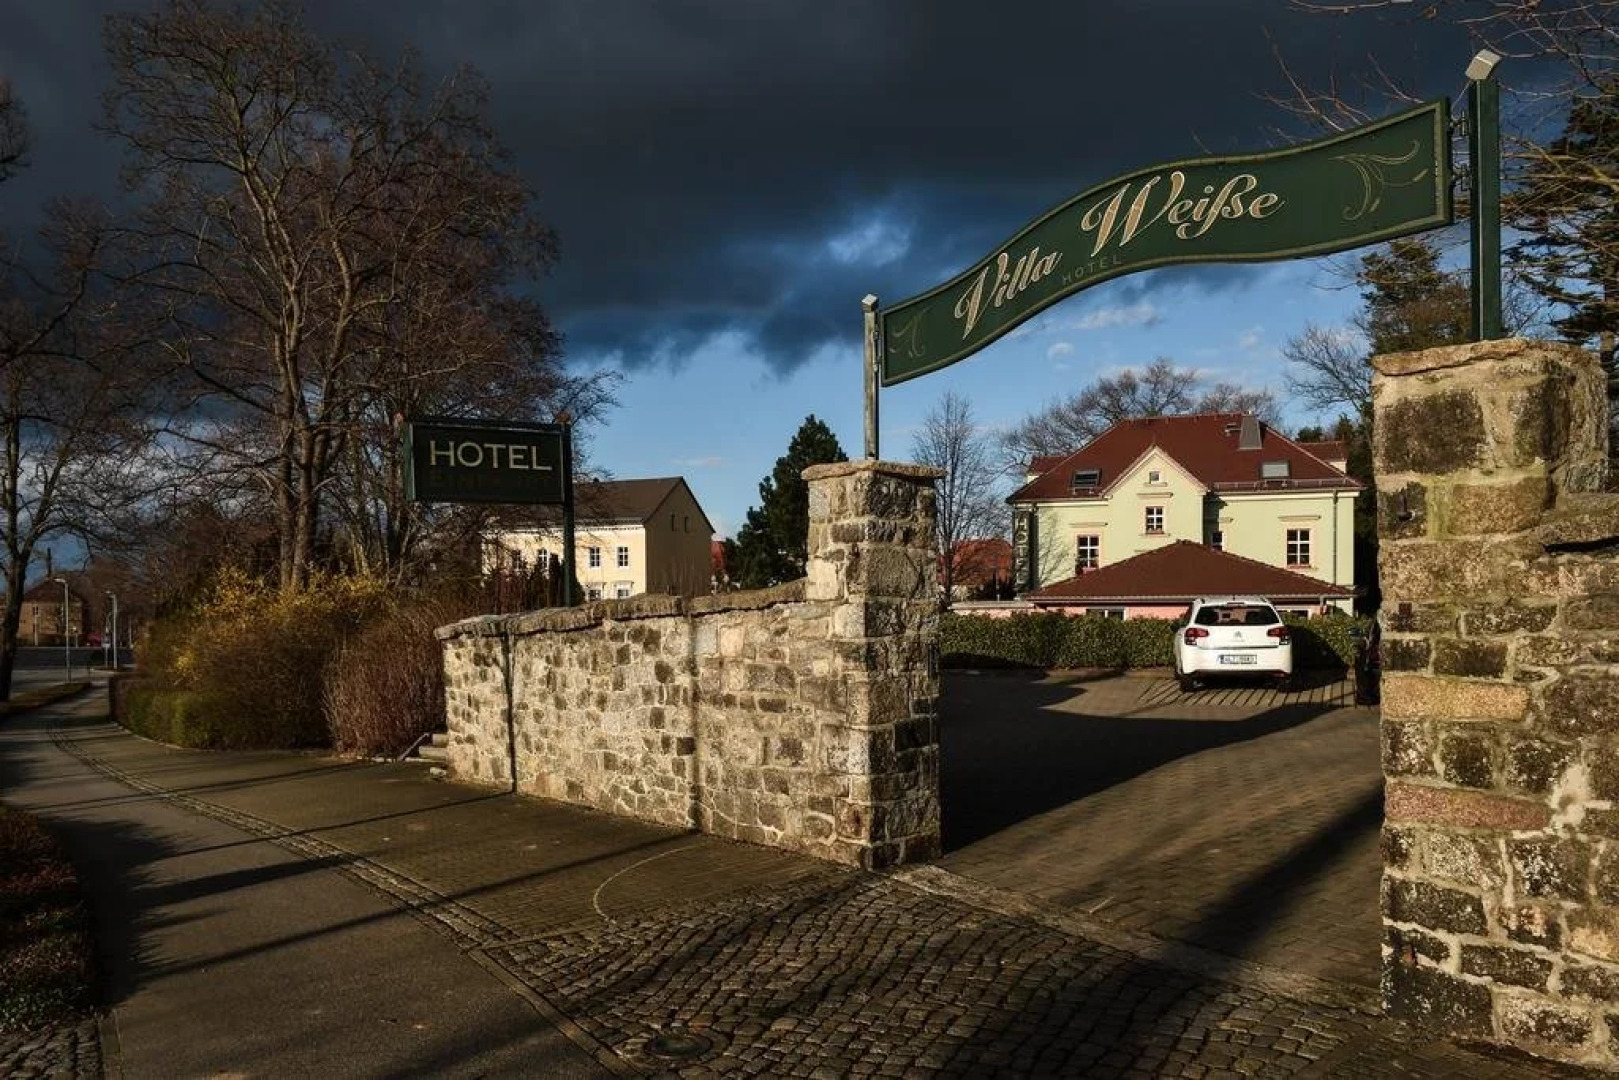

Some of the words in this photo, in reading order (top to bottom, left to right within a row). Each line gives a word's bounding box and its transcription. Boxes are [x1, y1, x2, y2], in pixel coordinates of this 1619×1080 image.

[953, 247, 1063, 341] Villa
[1081, 170, 1286, 257] Weiße
[1060, 253, 1124, 286] HOTEL
[429, 440, 553, 472] HOTEL
